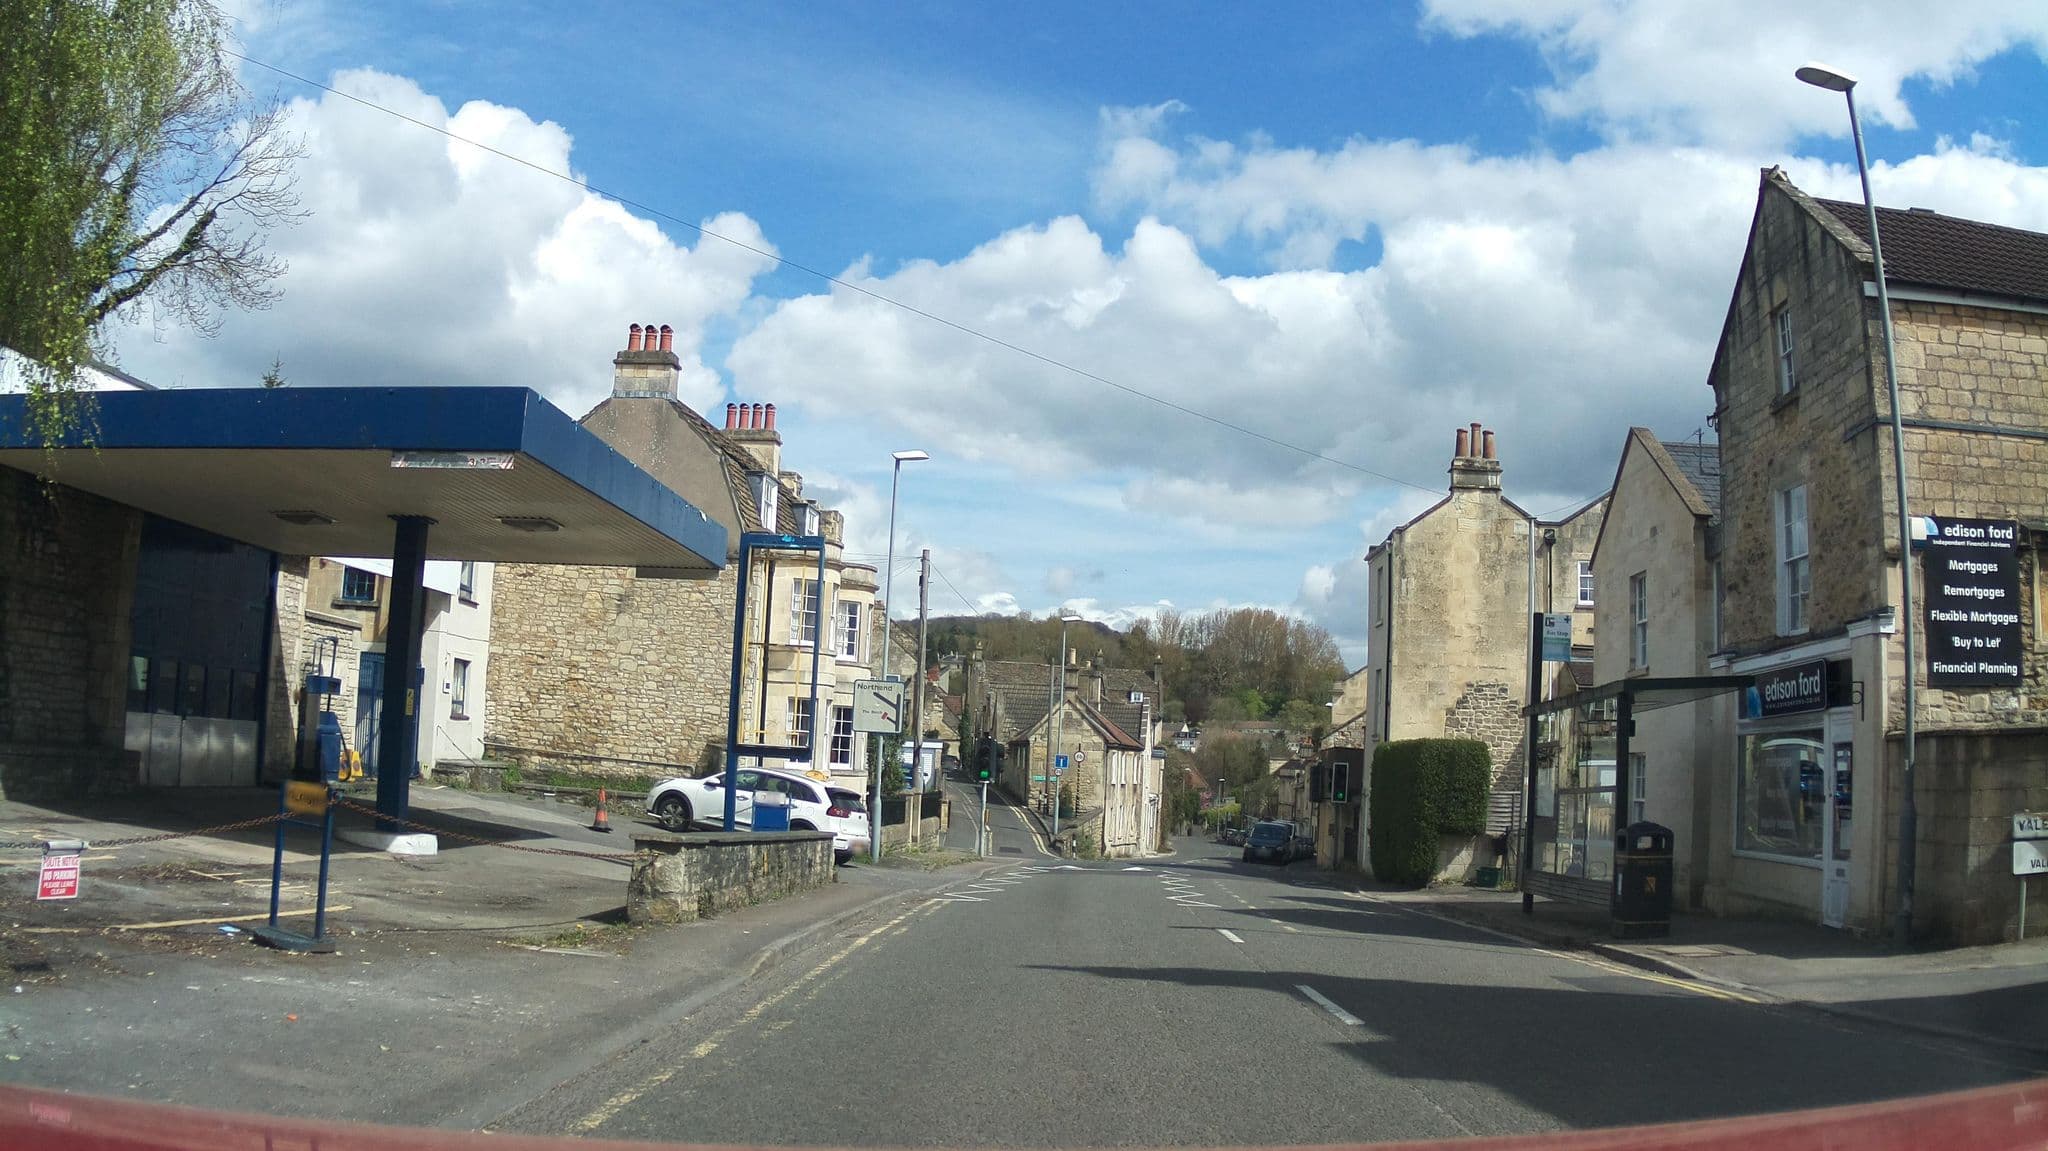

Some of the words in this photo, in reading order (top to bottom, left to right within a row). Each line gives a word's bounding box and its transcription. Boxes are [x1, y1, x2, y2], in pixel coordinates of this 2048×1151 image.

[1944, 524, 1984, 538] edison
[1988, 525, 2013, 539] ford
[1949, 560, 1998, 574] Mortgages
[1944, 585, 2005, 599] Remortgages
[1931, 610, 1968, 622] Flexible
[1970, 611, 2018, 625] Mortgages
[1974, 637, 1983, 648] to
[1933, 661, 1976, 673] Financial
[1979, 662, 2018, 676] Planning
[857, 683, 893, 692] Northend
[1765, 678, 1797, 701] edison
[1799, 668, 1820, 696] ford
[43, 871, 52, 880] NO
[53, 870, 76, 880] PARKING
